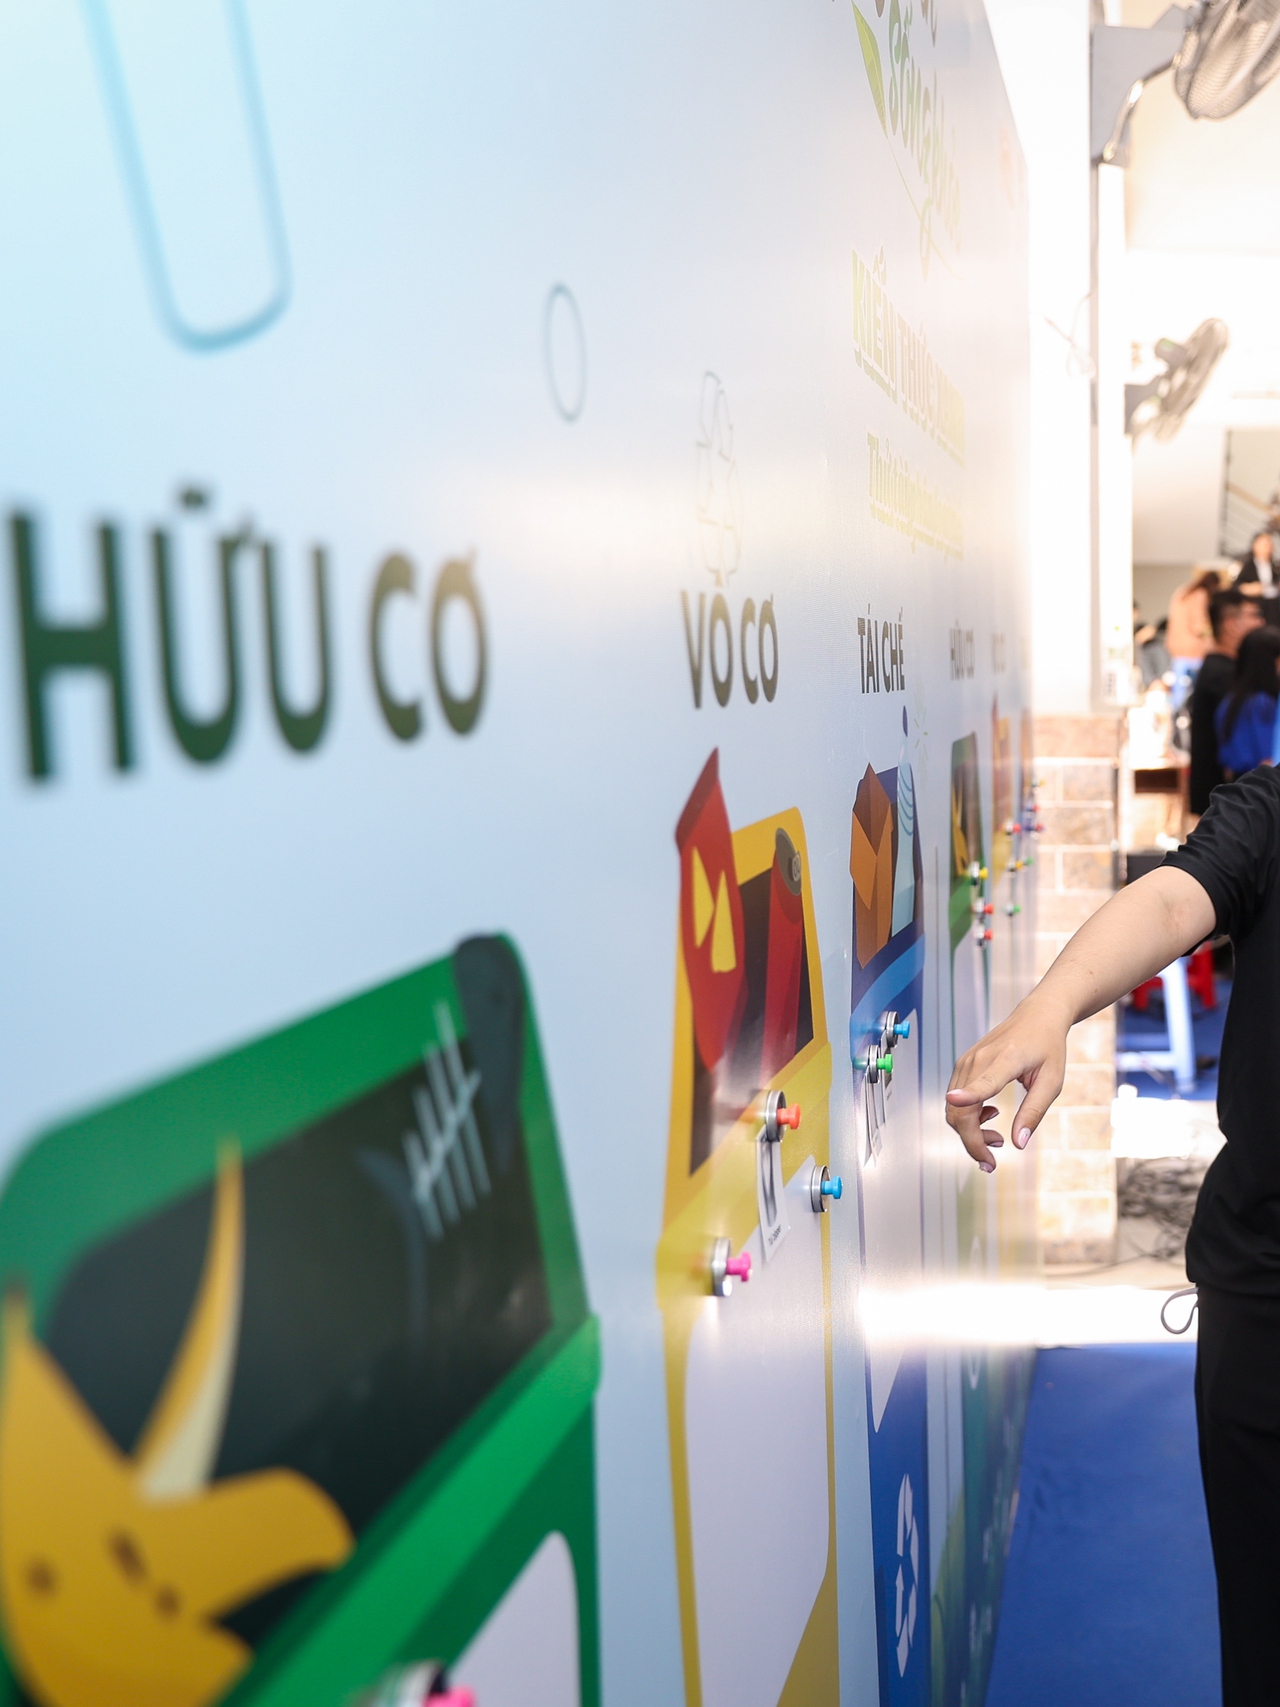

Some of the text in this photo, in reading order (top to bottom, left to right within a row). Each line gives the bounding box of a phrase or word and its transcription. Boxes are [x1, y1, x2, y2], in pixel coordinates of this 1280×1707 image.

[366, 545, 491, 745] CƠ
[740, 593, 779, 705] CƠ
[857, 603, 880, 694] TÁI
[881, 606, 905, 693] CHẾ
